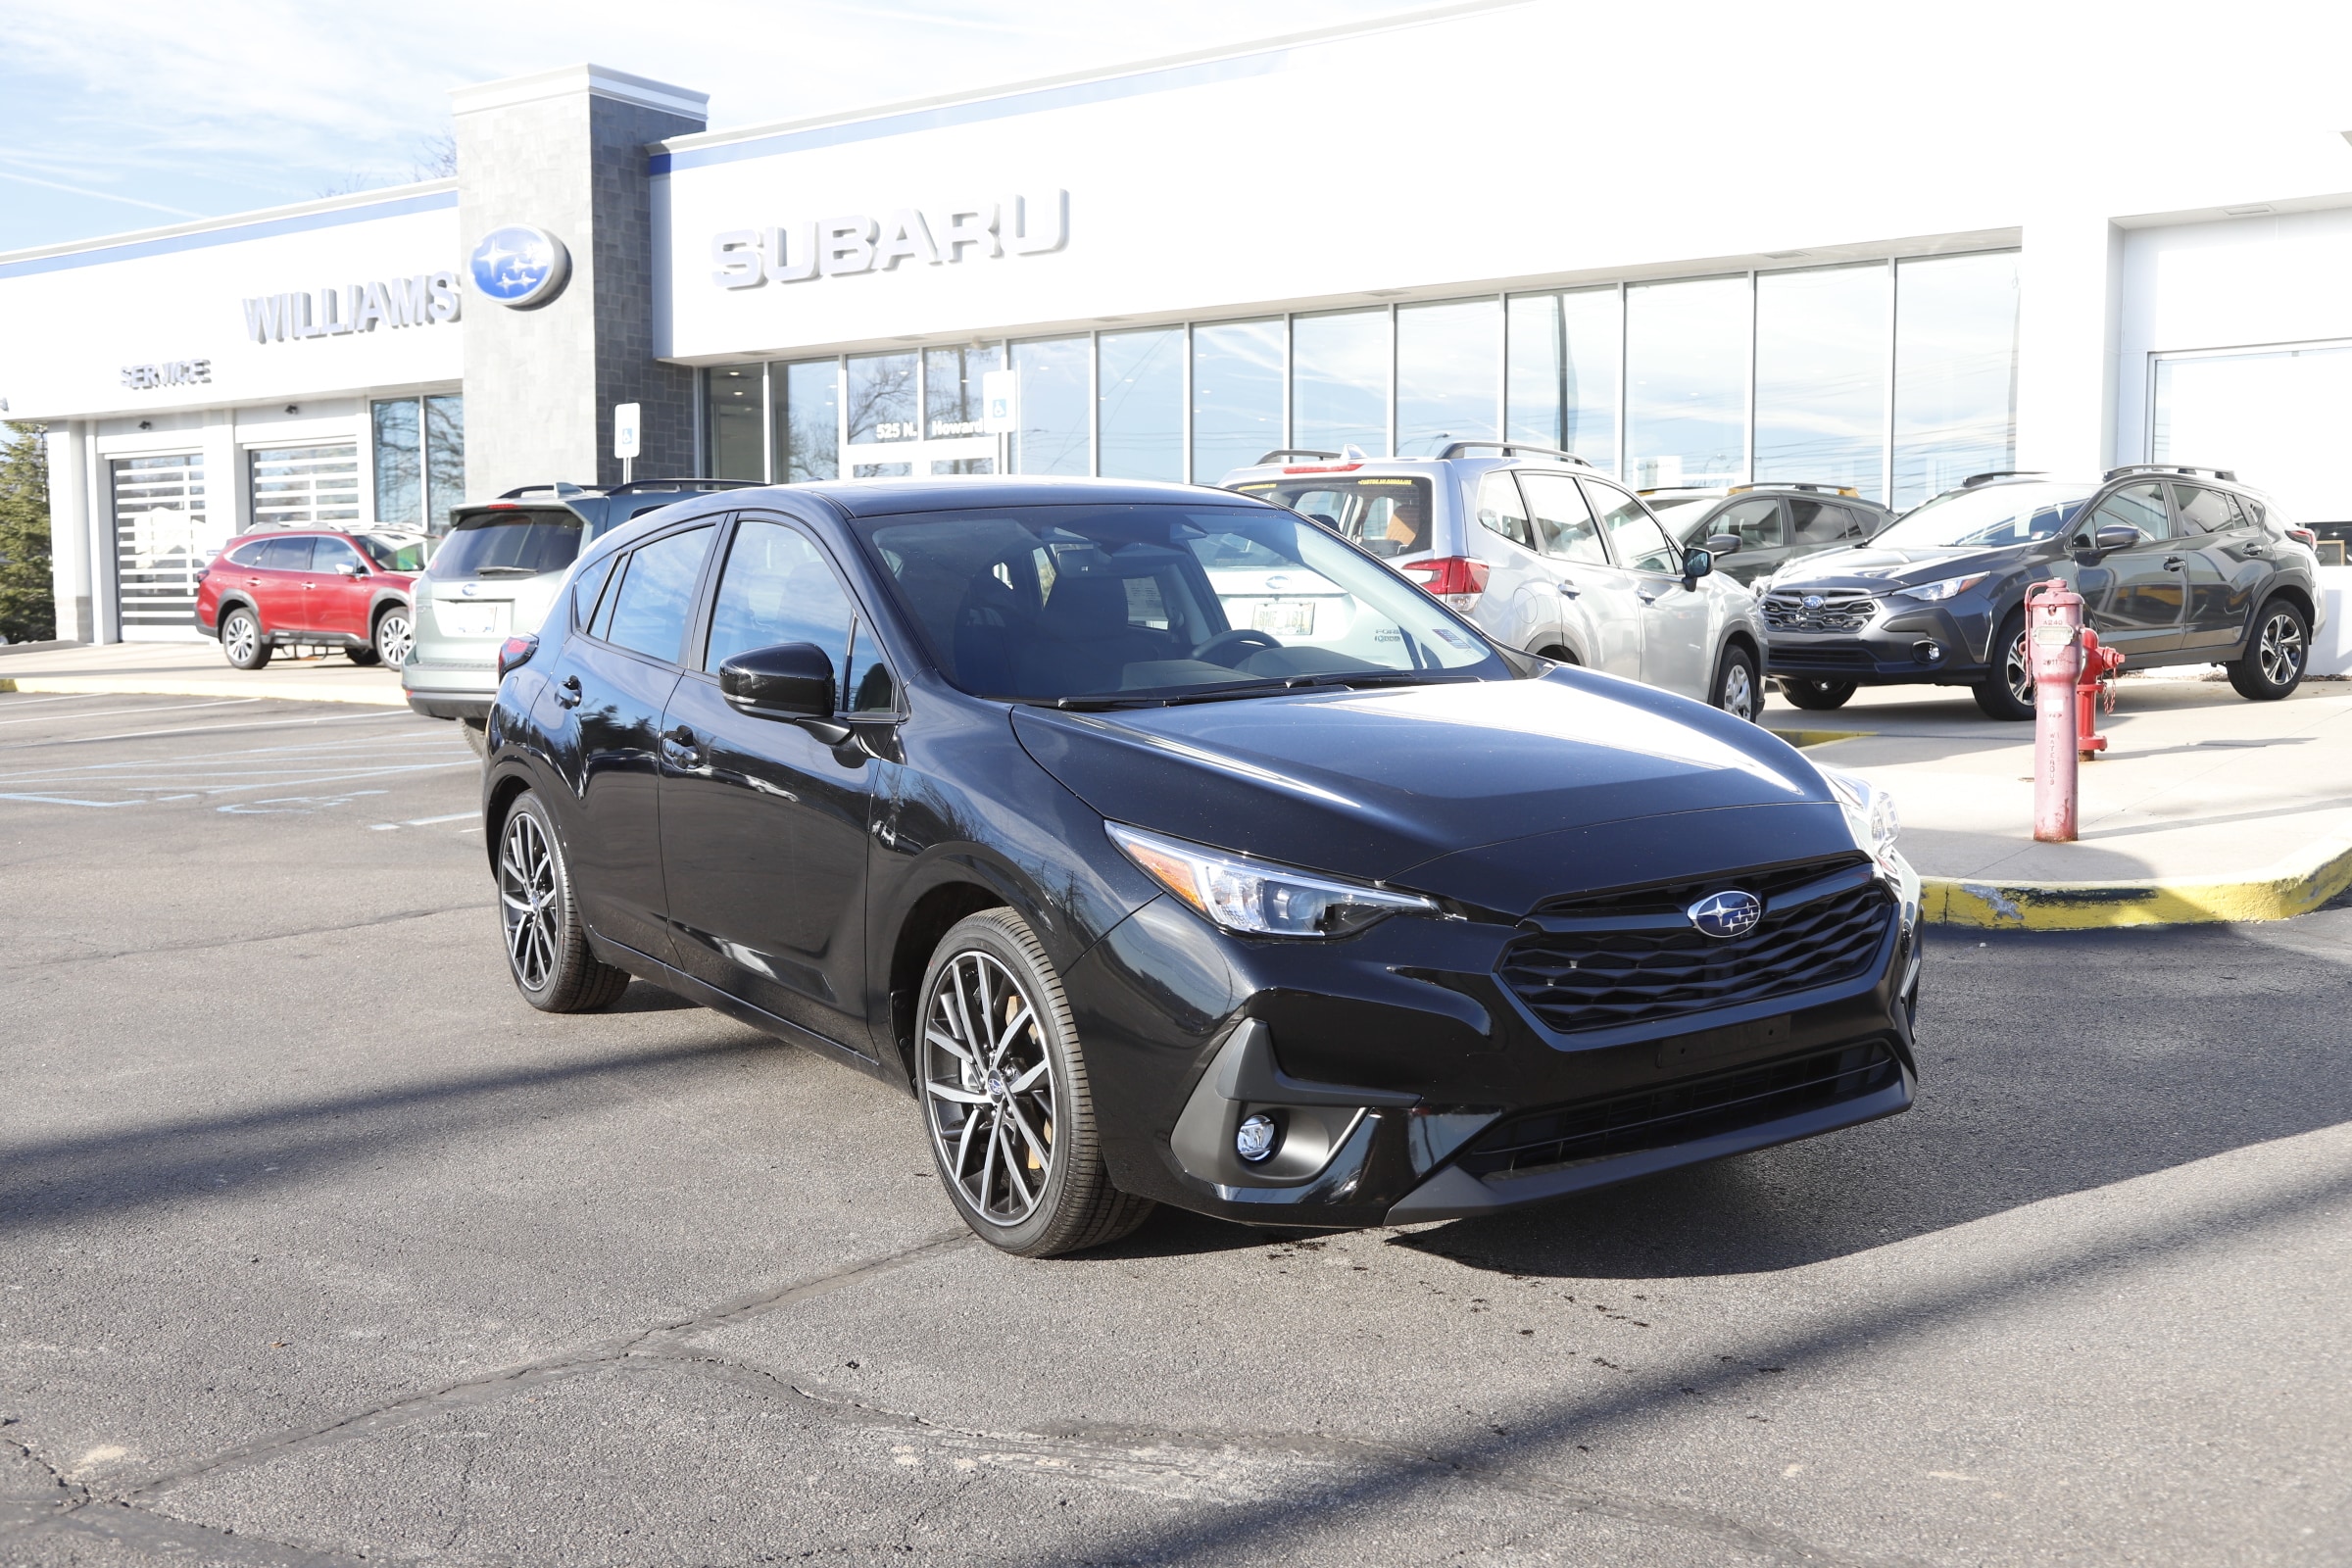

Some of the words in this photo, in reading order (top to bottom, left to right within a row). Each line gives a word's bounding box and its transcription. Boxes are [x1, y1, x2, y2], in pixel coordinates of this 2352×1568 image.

[710, 188, 1068, 291] SUBARU
[244, 270, 462, 344] WILLIAMS
[122, 360, 212, 389] SERVICE
[876, 422, 901, 439] 525
[903, 422, 917, 437] N.
[931, 418, 983, 435] Howard
